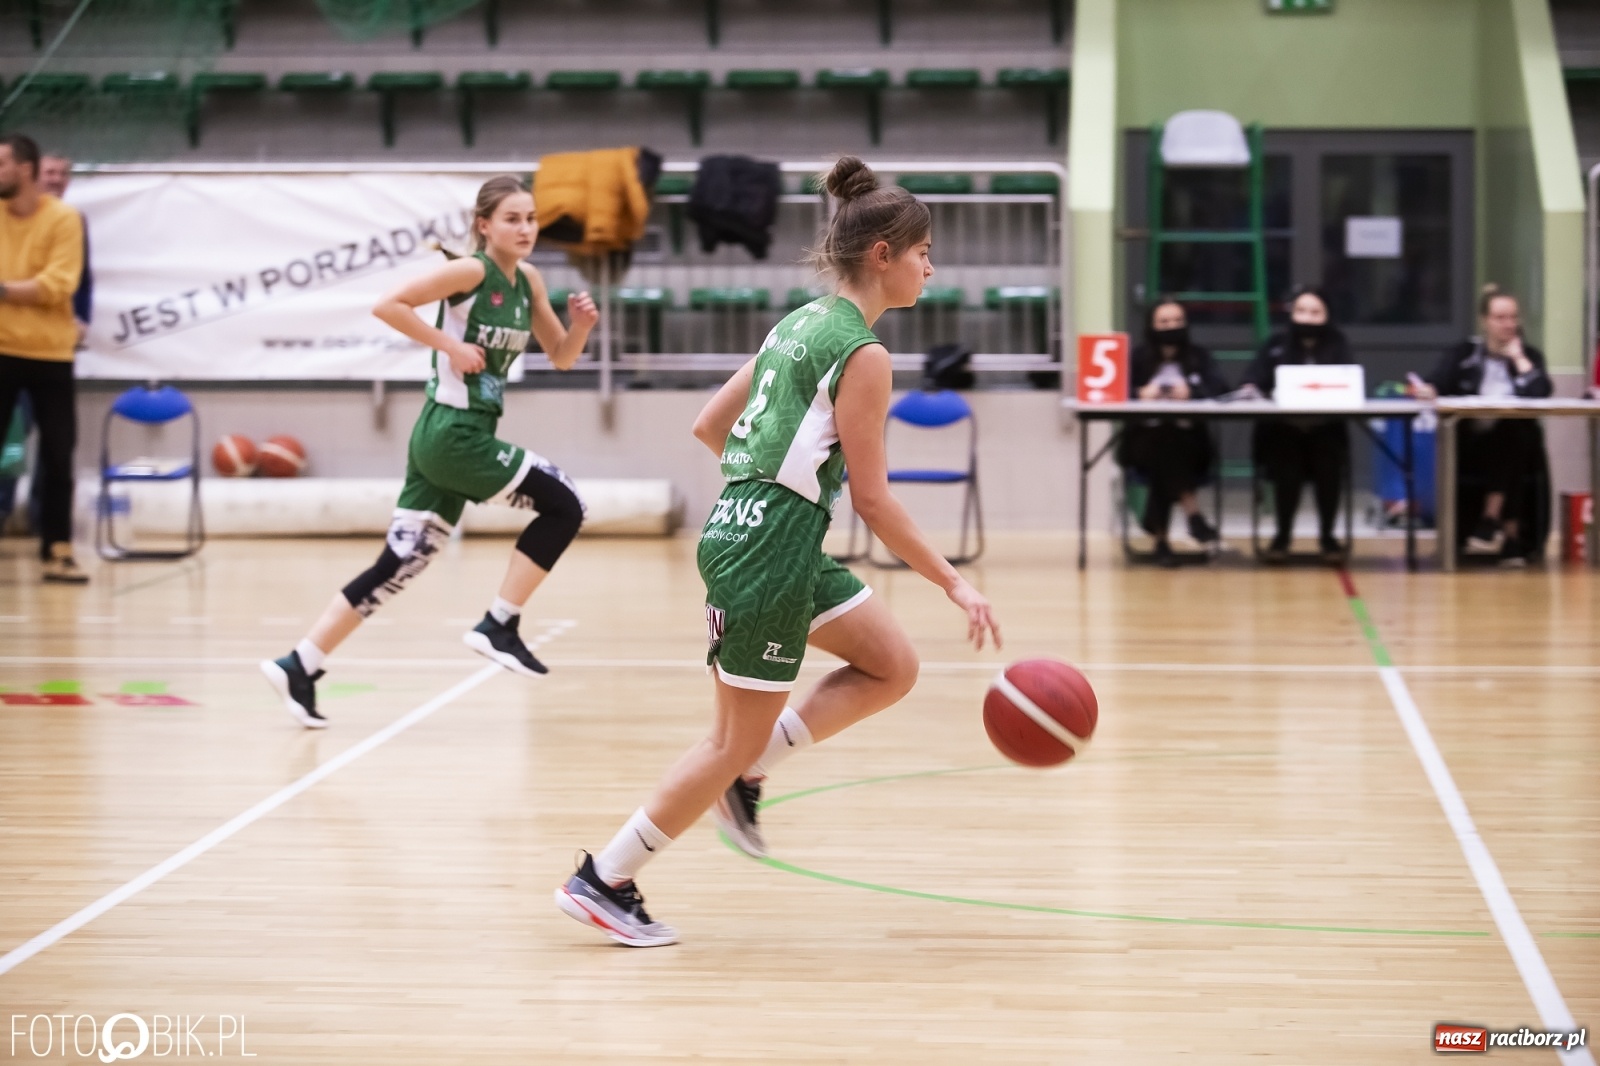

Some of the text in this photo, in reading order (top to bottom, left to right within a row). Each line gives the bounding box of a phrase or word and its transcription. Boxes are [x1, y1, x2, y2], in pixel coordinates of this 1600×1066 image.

[113, 289, 200, 343] JEST
[212, 276, 247, 307] W
[1084, 339, 1119, 389] 5
[731, 369, 776, 439] 5
[706, 498, 767, 527] TANS
